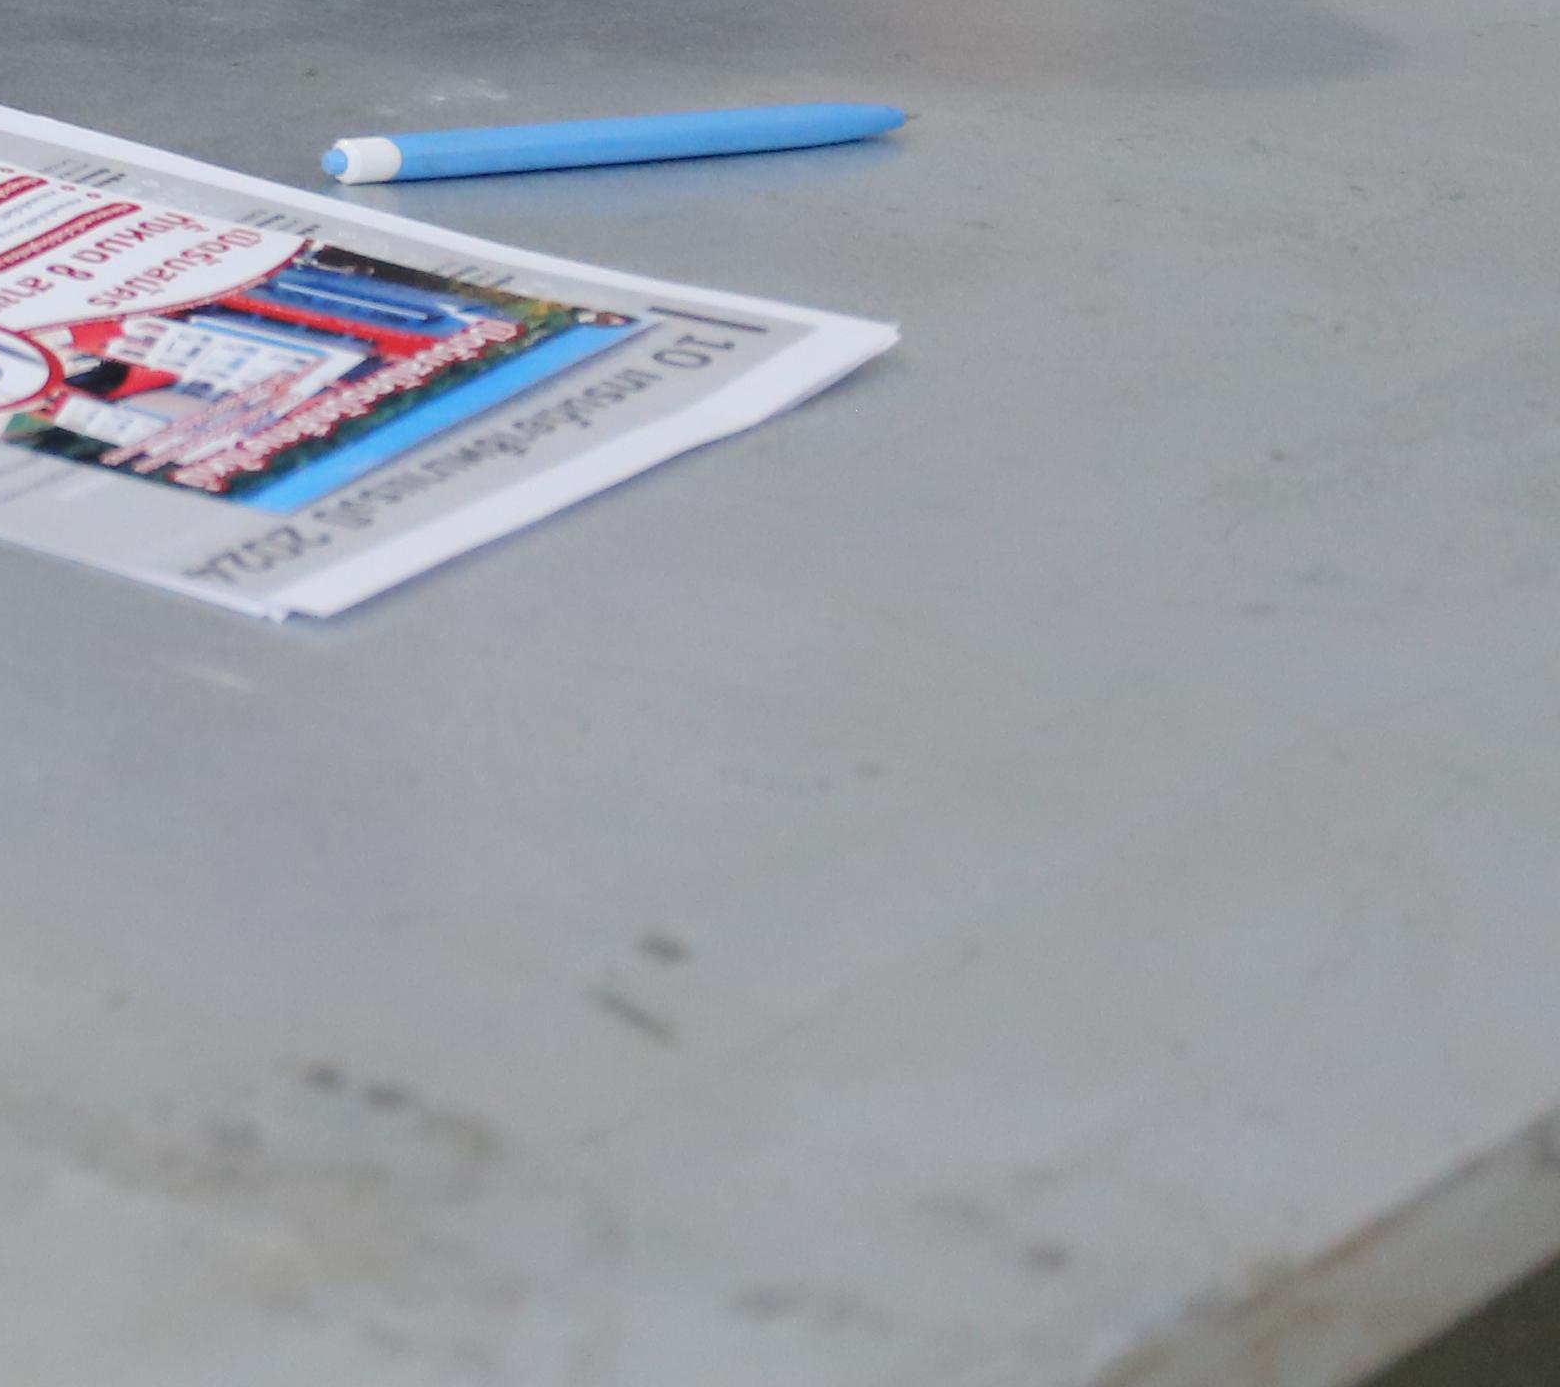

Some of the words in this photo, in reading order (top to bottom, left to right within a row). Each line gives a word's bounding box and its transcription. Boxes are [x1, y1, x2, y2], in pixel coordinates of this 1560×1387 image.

[72, 212, 209, 264] ทั้งหมด
[47, 264, 96, 280] 8
[87, 227, 264, 310] เปิดรับสมัคร
[652, 333, 737, 372] 10
[182, 521, 332, 585] 2024
